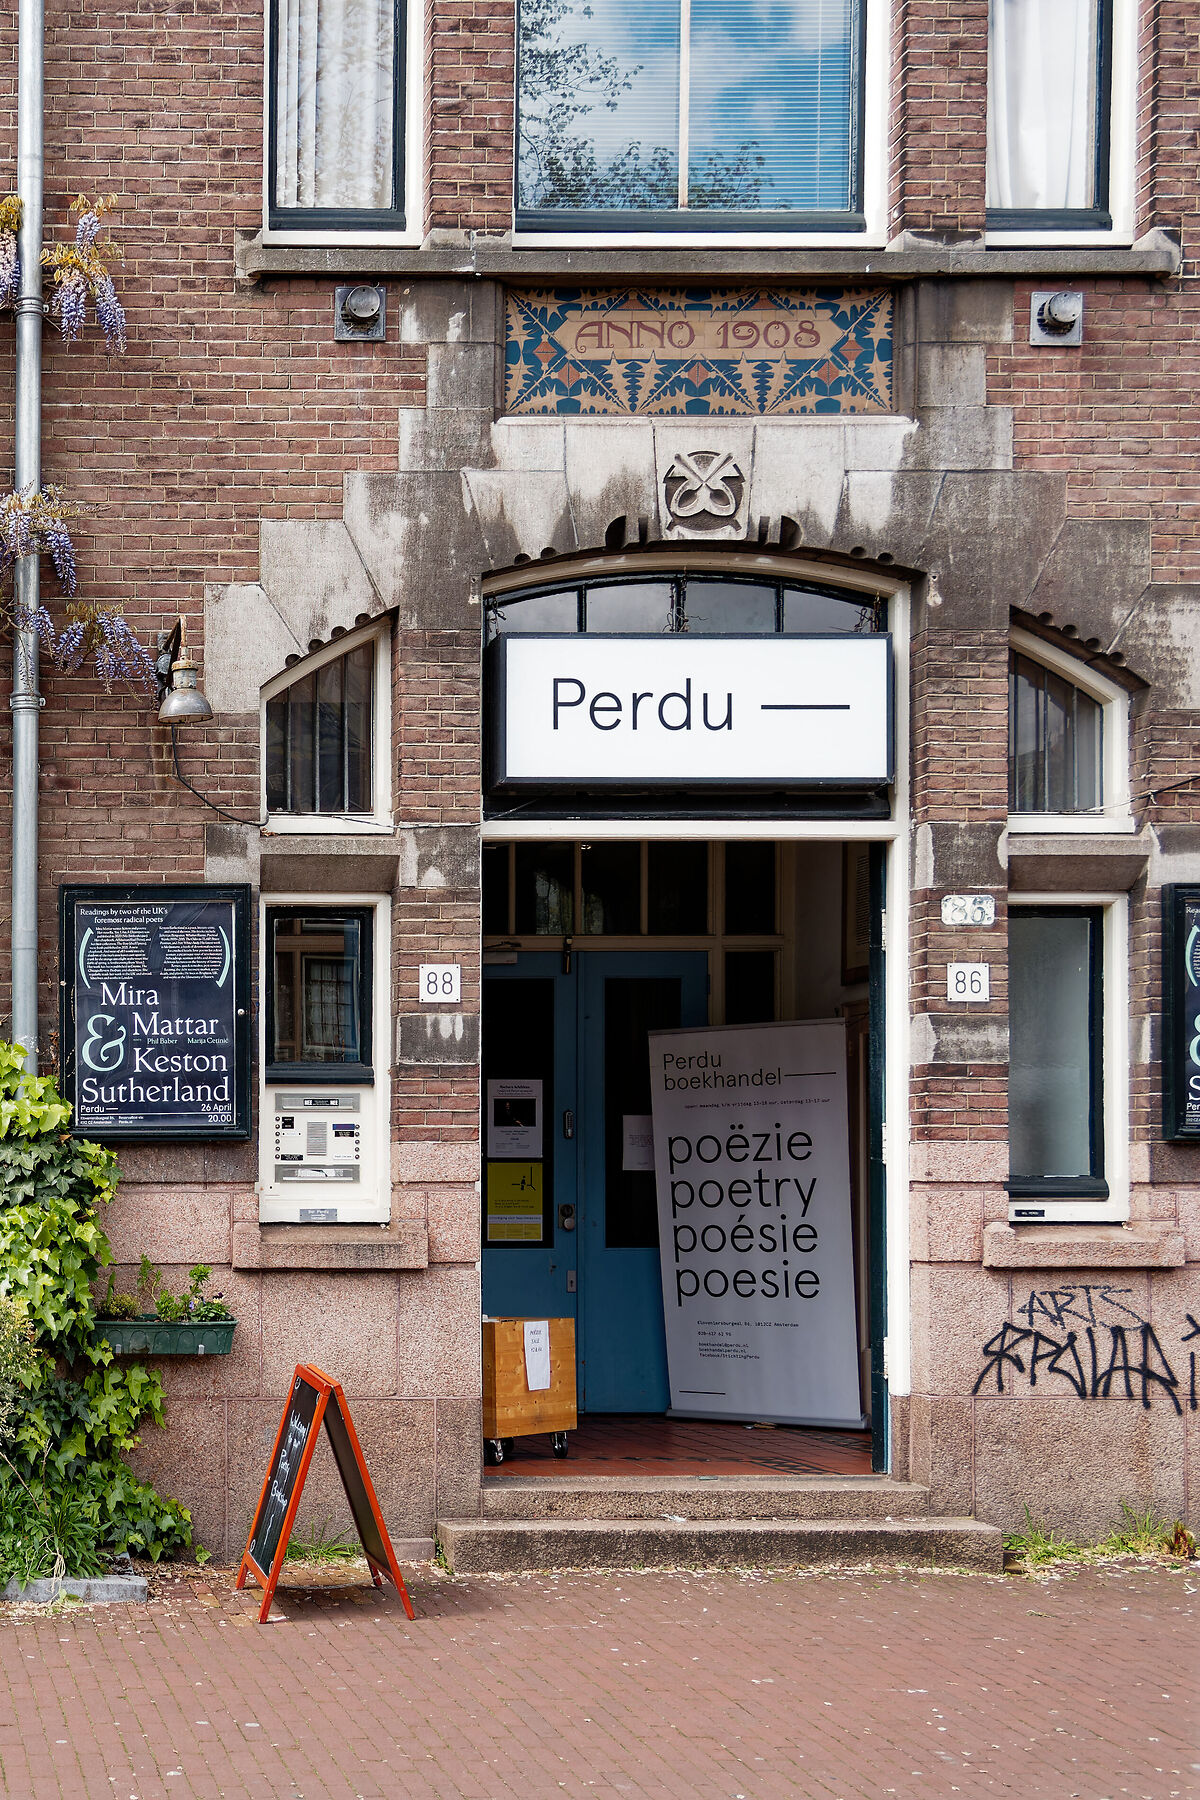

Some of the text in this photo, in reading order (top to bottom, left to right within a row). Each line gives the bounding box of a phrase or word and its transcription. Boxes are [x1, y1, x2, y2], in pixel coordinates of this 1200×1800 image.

[575, 319, 821, 353] ANNO 1908
[552, 677, 733, 731] Perdu
[80, 908, 109, 917] Readings
[110, 908, 118, 916] by
[132, 907, 140, 915] of
[140, 907, 151, 915] the
[152, 907, 168, 915] UK's
[94, 916, 123, 924] foremost
[100, 982, 160, 1006] Mira
[426, 970, 454, 996] 88
[955, 970, 982, 994] 86
[132, 1011, 219, 1036] Mattar
[81, 1014, 127, 1072] &
[147, 1037, 159, 1045] Phil
[159, 1037, 178, 1045] Baber
[133, 1047, 228, 1073] Keston
[663, 1051, 722, 1070] Perdu
[81, 1076, 231, 1104] Sutherland
[664, 1067, 782, 1091] boekhandel
[80, 1105, 105, 1113] Perdu
[201, 1103, 232, 1113] 26 April
[208, 1114, 232, 1123] 20.00
[1186, 1102, 1200, 1111] Per
[668, 1122, 812, 1174] poëzie
[670, 1168, 817, 1218] poetry
[673, 1214, 818, 1262] poésie
[676, 1259, 820, 1307] poesie
